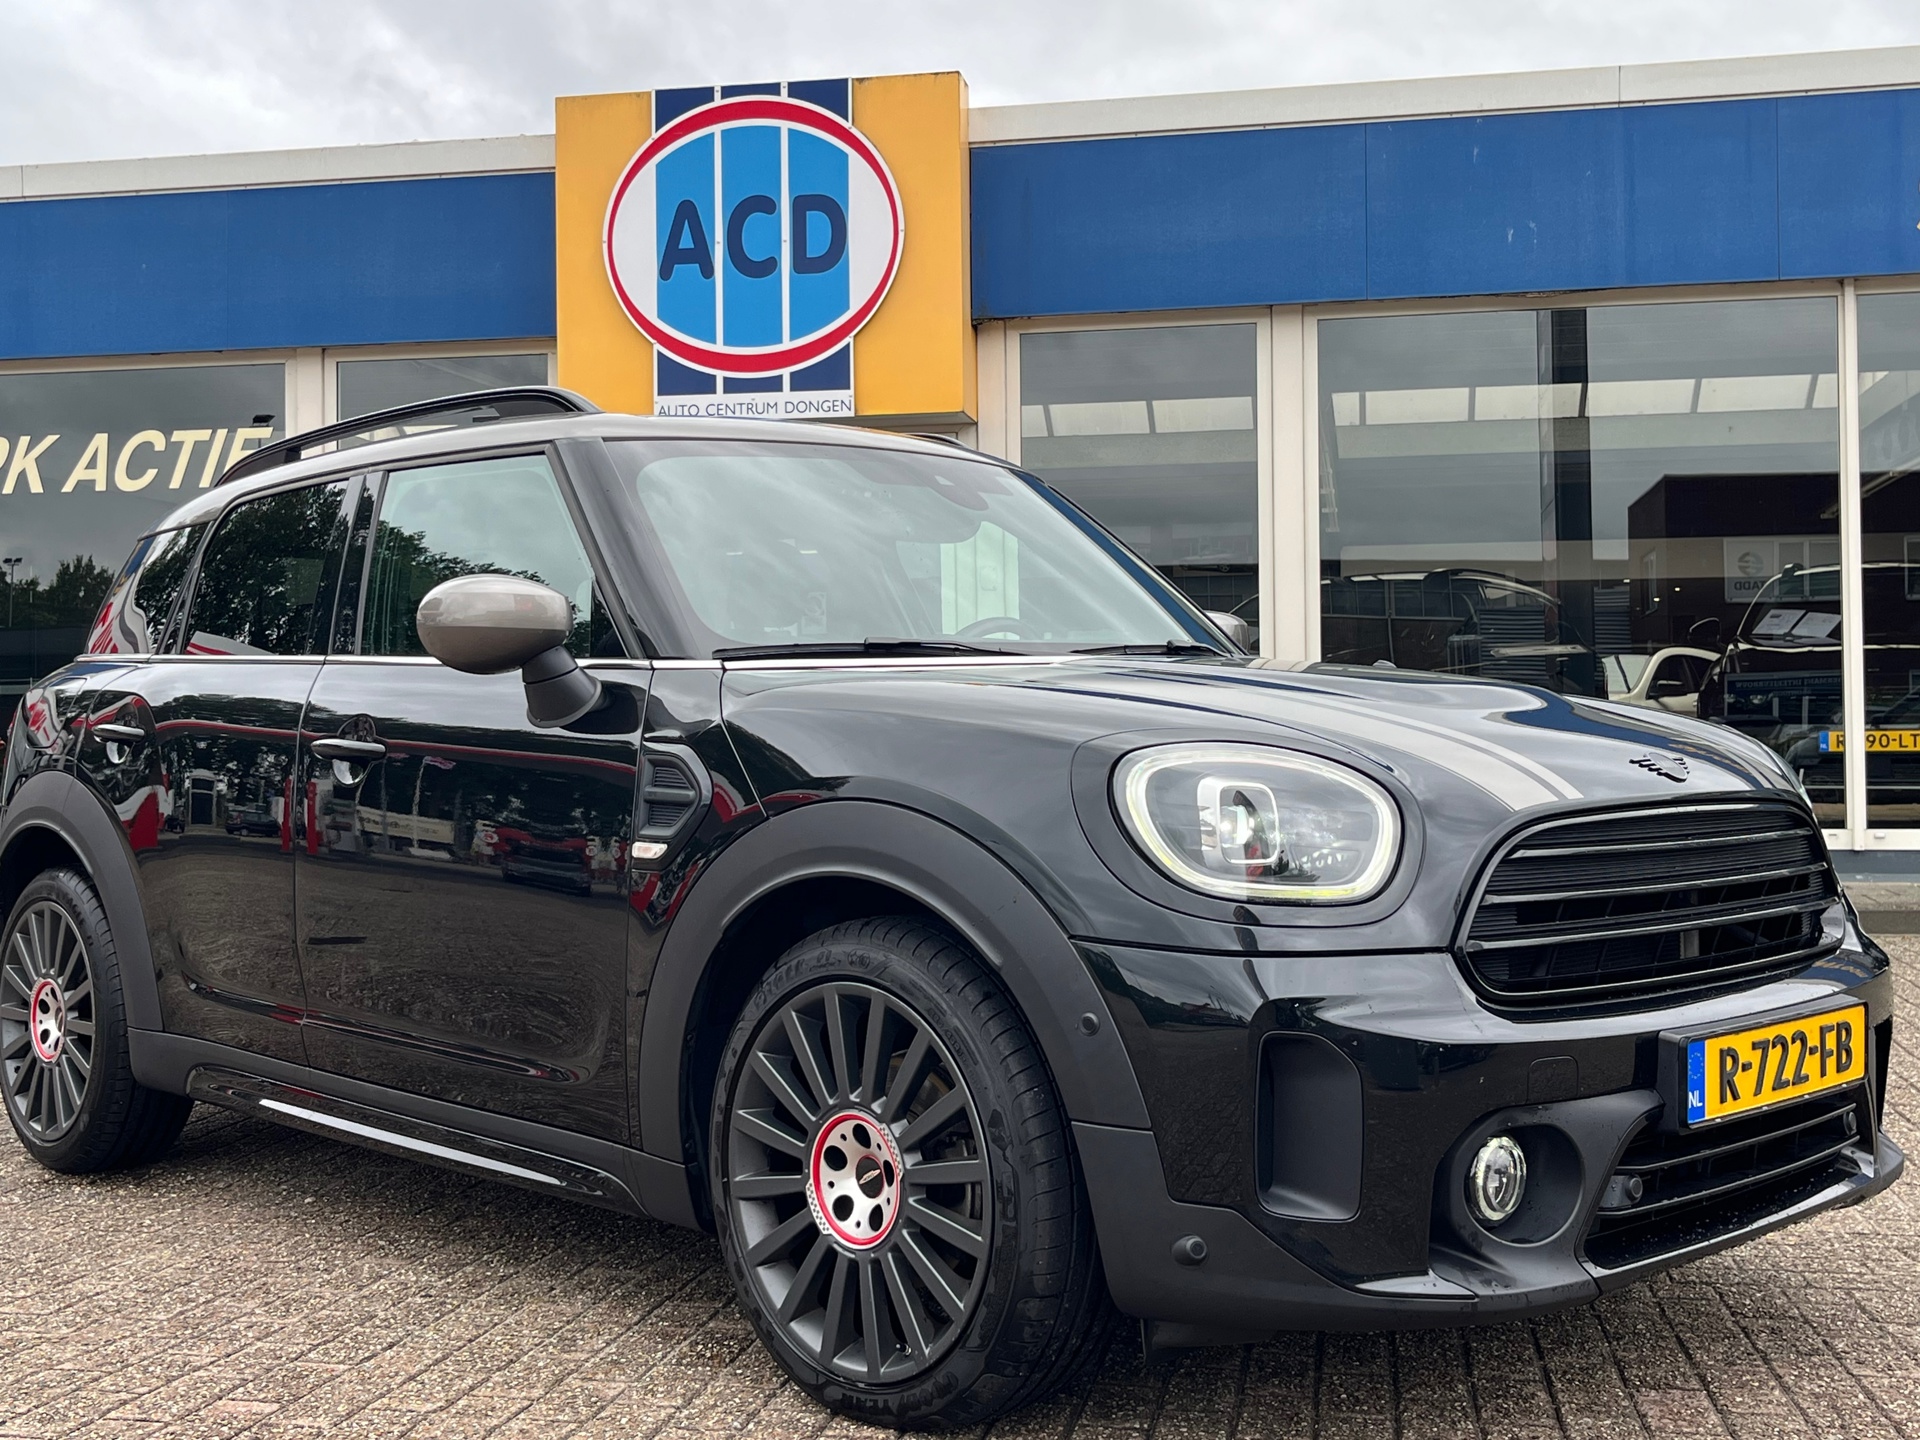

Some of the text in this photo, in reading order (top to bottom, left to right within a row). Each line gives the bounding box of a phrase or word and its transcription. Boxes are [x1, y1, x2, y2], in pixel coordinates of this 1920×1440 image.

[659, 194, 847, 281] ACD
[658, 400, 851, 416] AUTO CENTRUM DONGEN
[1719, 1020, 1853, 1104] R-722-FB
[1688, 1090, 1703, 1109] NL
